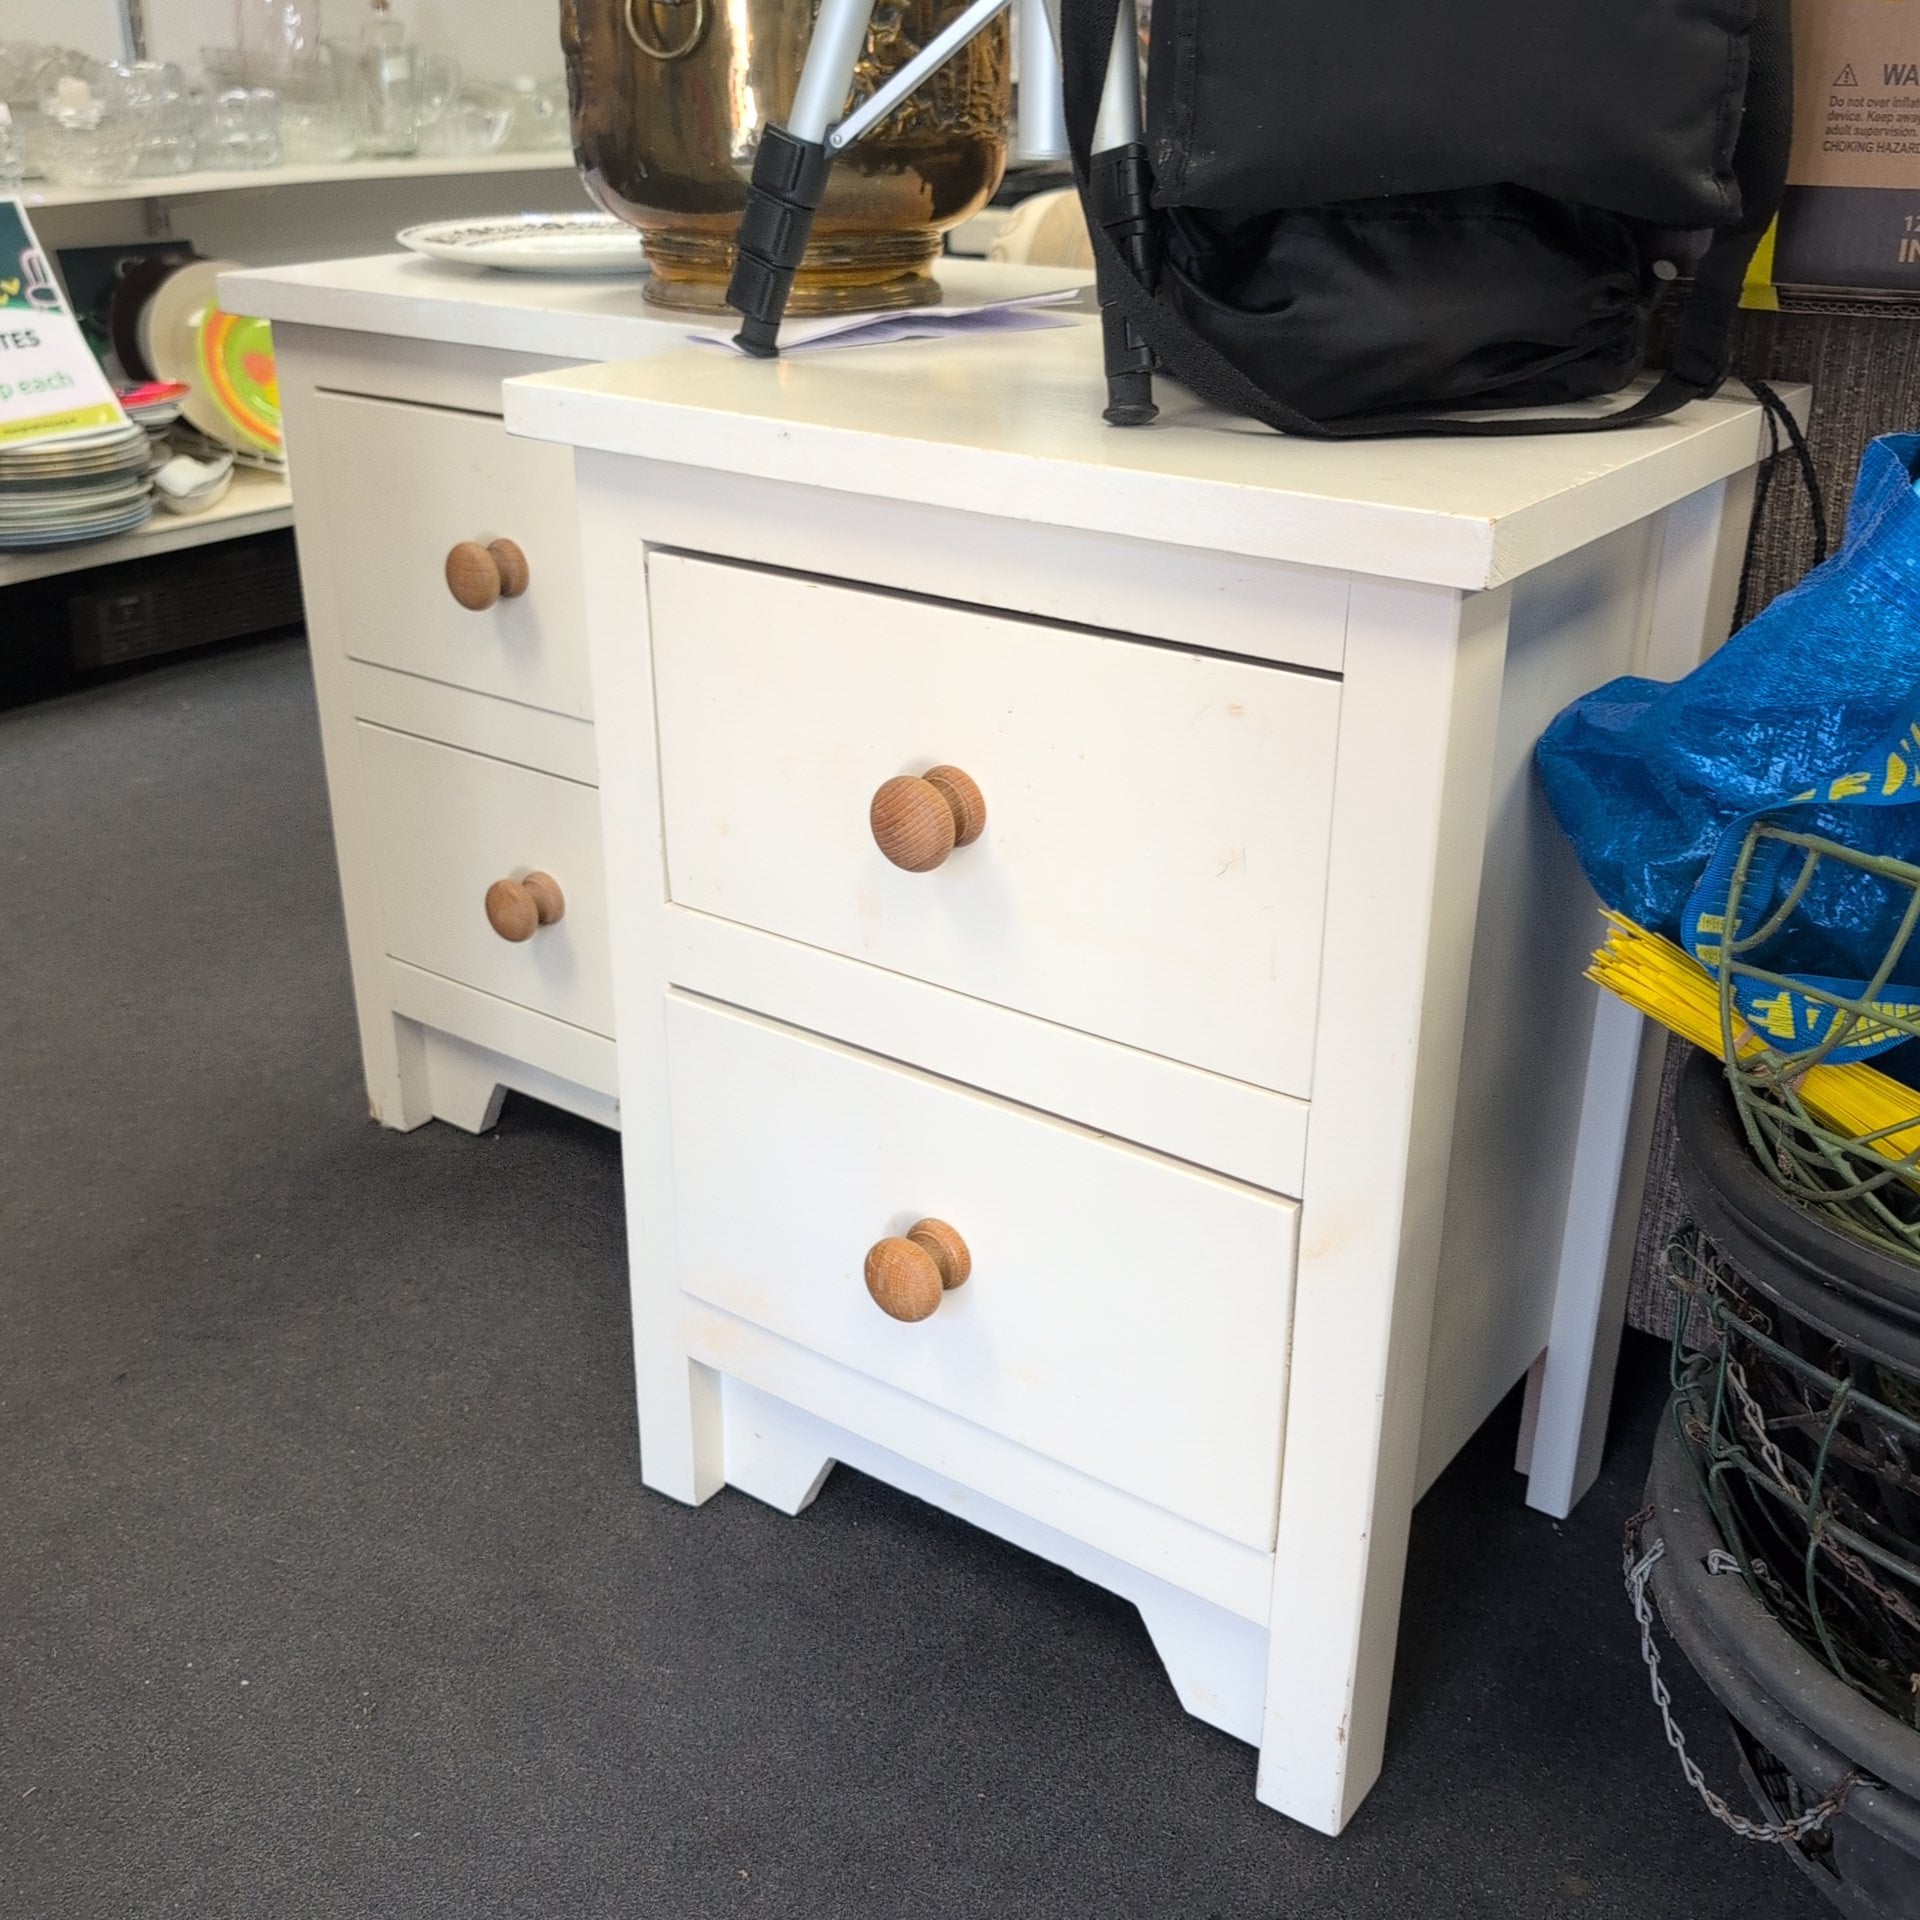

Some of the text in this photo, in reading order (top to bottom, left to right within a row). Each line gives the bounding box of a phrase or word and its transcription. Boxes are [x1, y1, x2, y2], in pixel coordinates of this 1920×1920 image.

[1884, 64, 1919, 86] WA
[1829, 95, 1845, 108] Do
[1847, 97, 1865, 108] not
[1867, 98, 1890, 108] over
[1866, 111, 1893, 124] Keep
[1823, 141, 1874, 153] CHOKING
[17, 370, 75, 395] each
